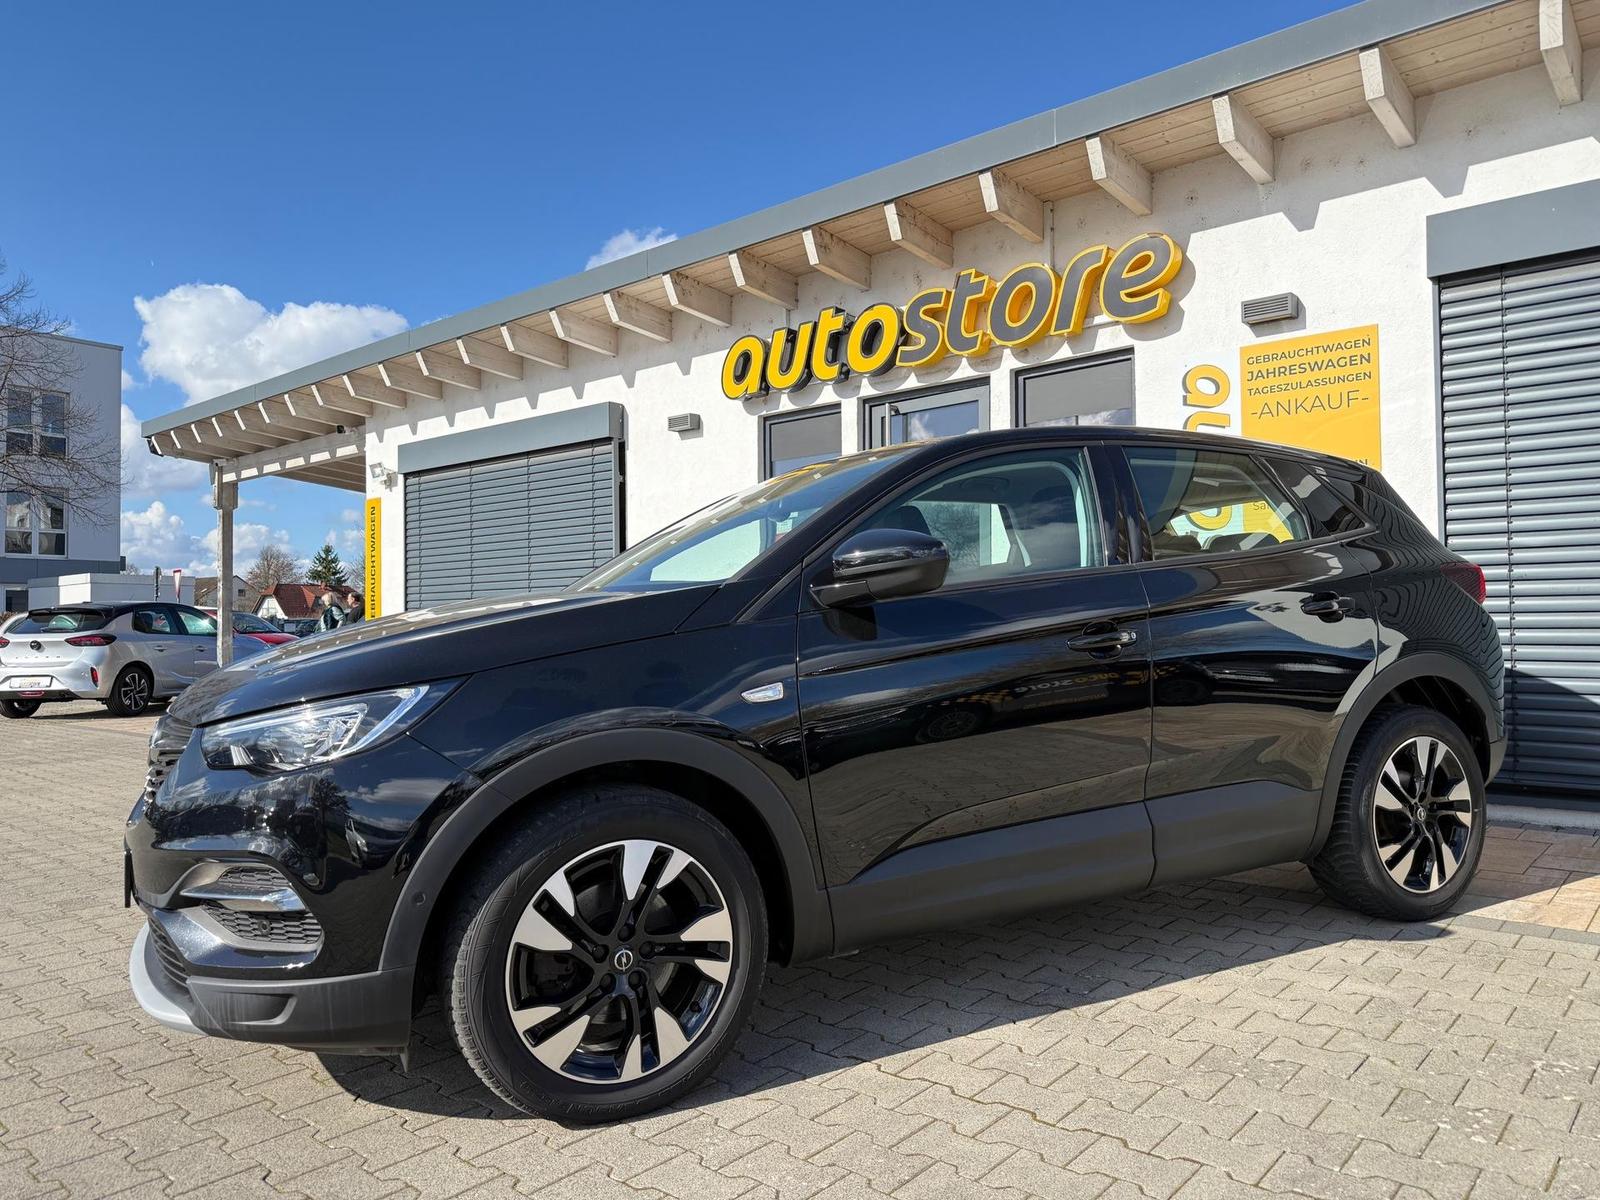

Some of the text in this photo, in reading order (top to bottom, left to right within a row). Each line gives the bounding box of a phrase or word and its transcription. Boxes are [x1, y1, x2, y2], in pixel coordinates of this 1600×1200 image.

[721, 232, 1183, 400] autostore
[1246, 337, 1371, 366] GEBRAUCHTWAGEN
[1246, 353, 1371, 382] JAHRESWAGEN
[1247, 371, 1372, 396] TAGESZULASSUNGEN
